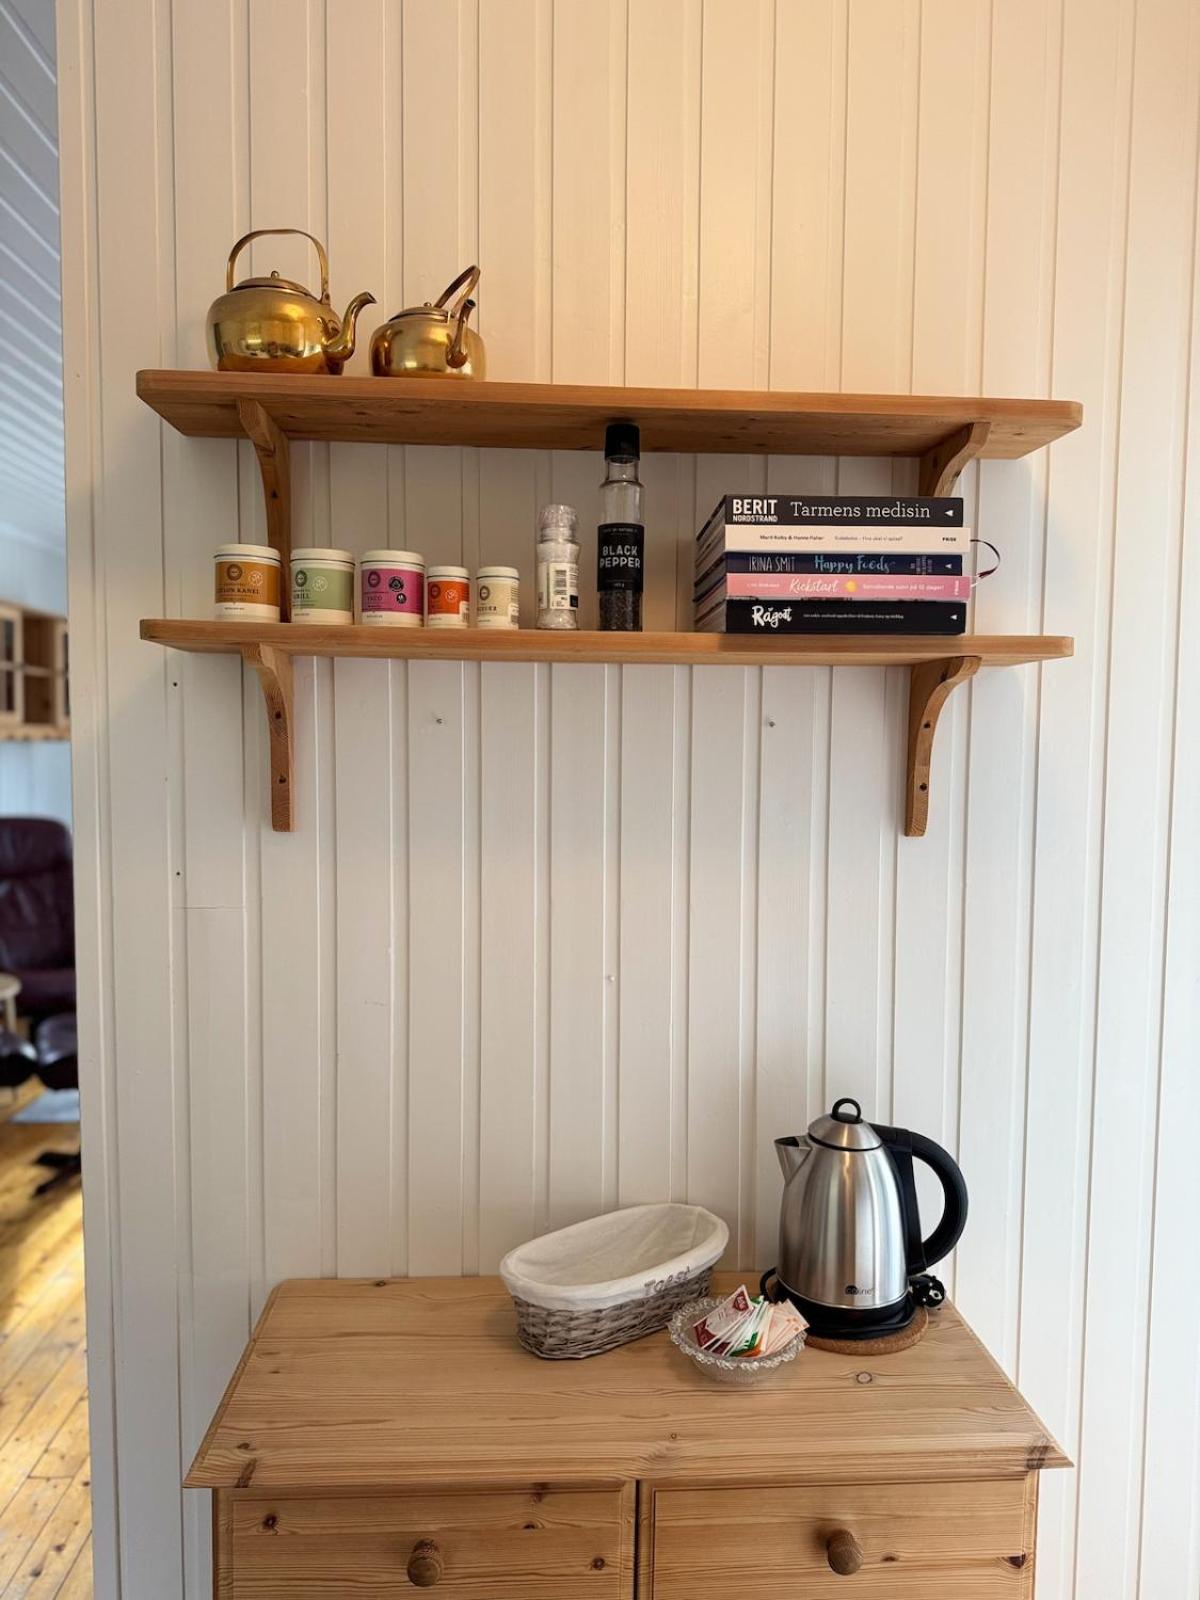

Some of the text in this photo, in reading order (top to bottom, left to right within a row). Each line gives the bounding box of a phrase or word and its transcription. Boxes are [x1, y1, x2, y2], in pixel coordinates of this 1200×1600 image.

[732, 499, 778, 514] BERIT
[790, 501, 930, 518] Tarmens medisin
[732, 514, 778, 523] NORDSTRAND
[602, 544, 638, 556] BLACK
[599, 556, 641, 569] PEPPER
[749, 556, 796, 572] IRINA SMIT
[814, 555, 854, 573] Happy
[856, 554, 890, 573] Foods
[789, 578, 839, 594] Kickstart
